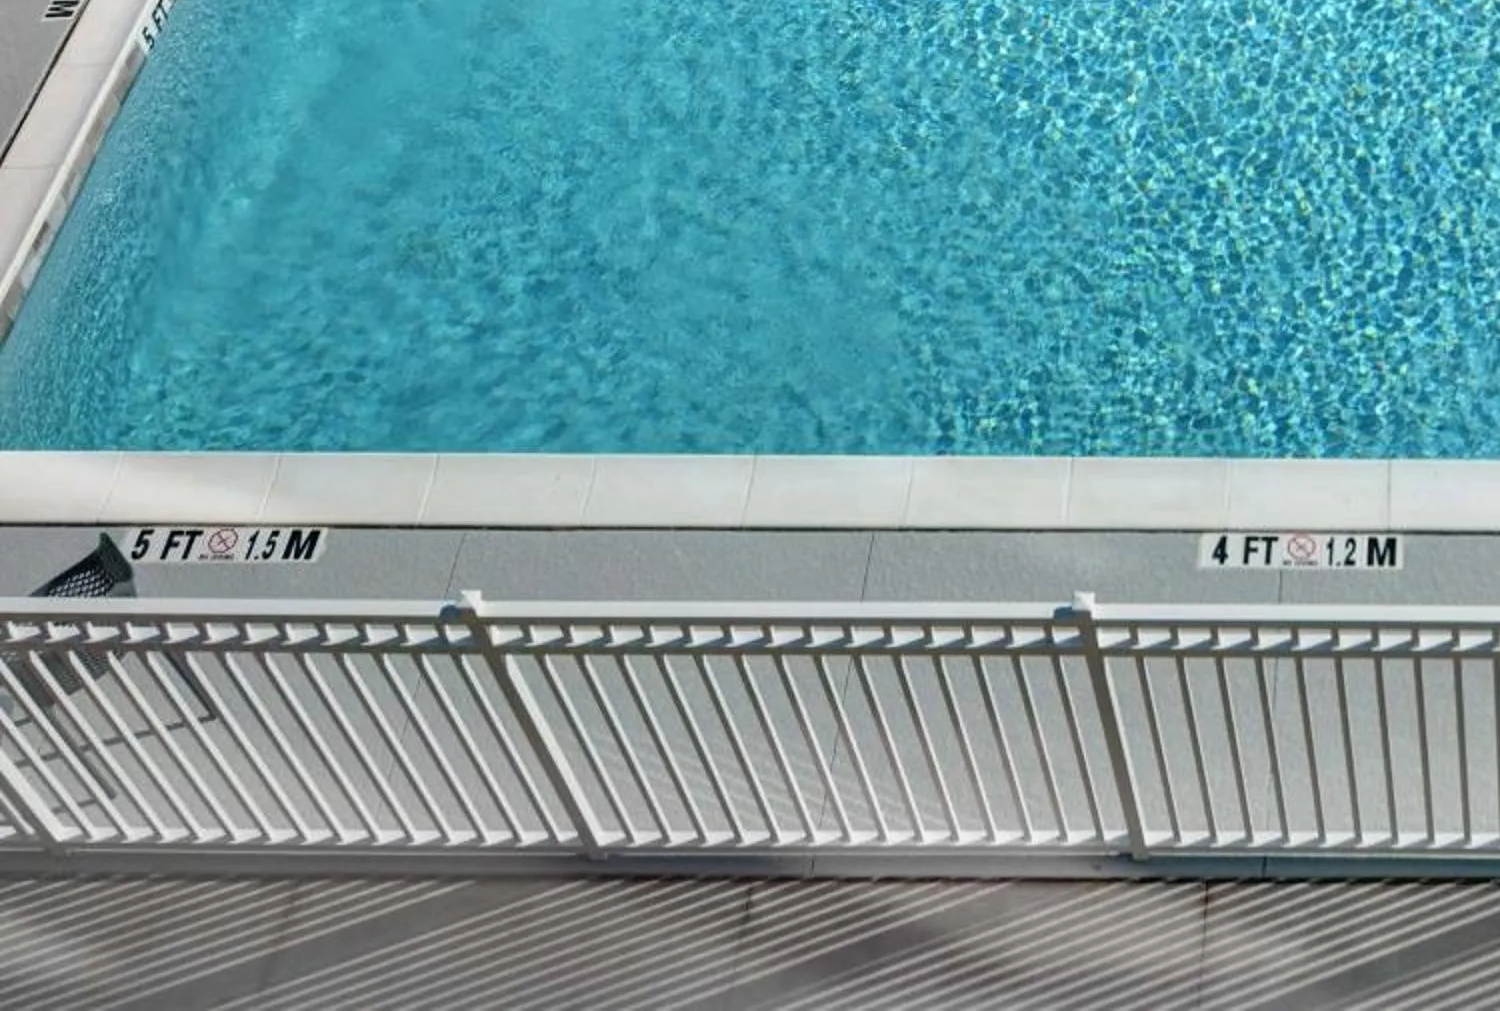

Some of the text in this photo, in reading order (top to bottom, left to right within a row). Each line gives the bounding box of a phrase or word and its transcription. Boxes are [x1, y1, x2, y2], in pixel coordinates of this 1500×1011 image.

[45, 0, 80, 18] M
[141, 26, 155, 50] 5
[132, 529, 321, 560] 5 FT 1.5 M
[1212, 536, 1397, 566] 4 FT 1.2 M
